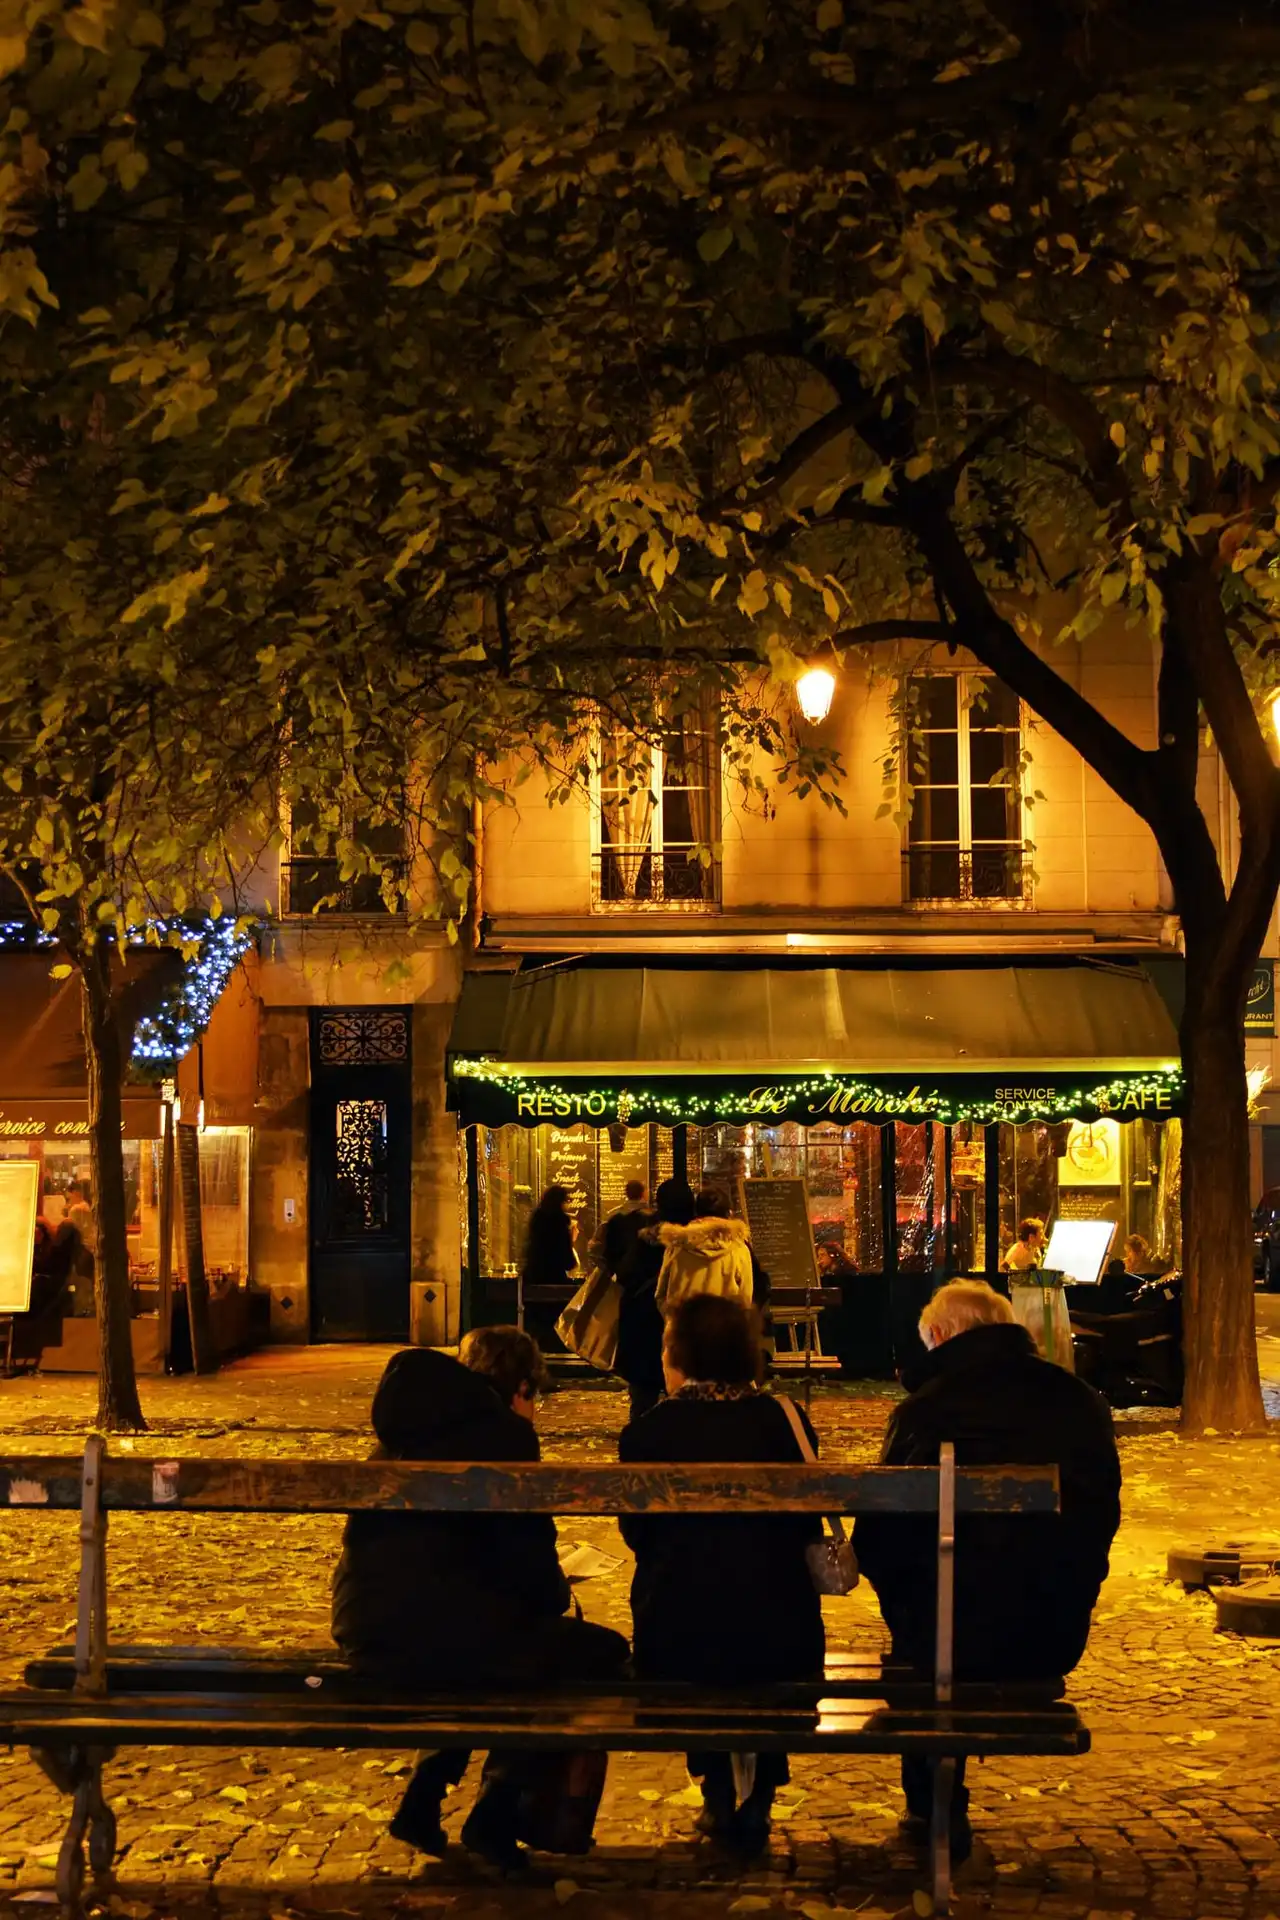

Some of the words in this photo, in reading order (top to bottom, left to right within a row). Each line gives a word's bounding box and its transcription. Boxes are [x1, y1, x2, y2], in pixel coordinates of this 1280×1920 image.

[518, 1093, 606, 1115] RESTO
[744, 1086, 788, 1114] Le
[807, 1085, 938, 1114] Marché
[995, 1088, 1056, 1100] SERVICE
[1107, 1089, 1172, 1111] CAFE
[0, 1111, 46, 1135] ervice
